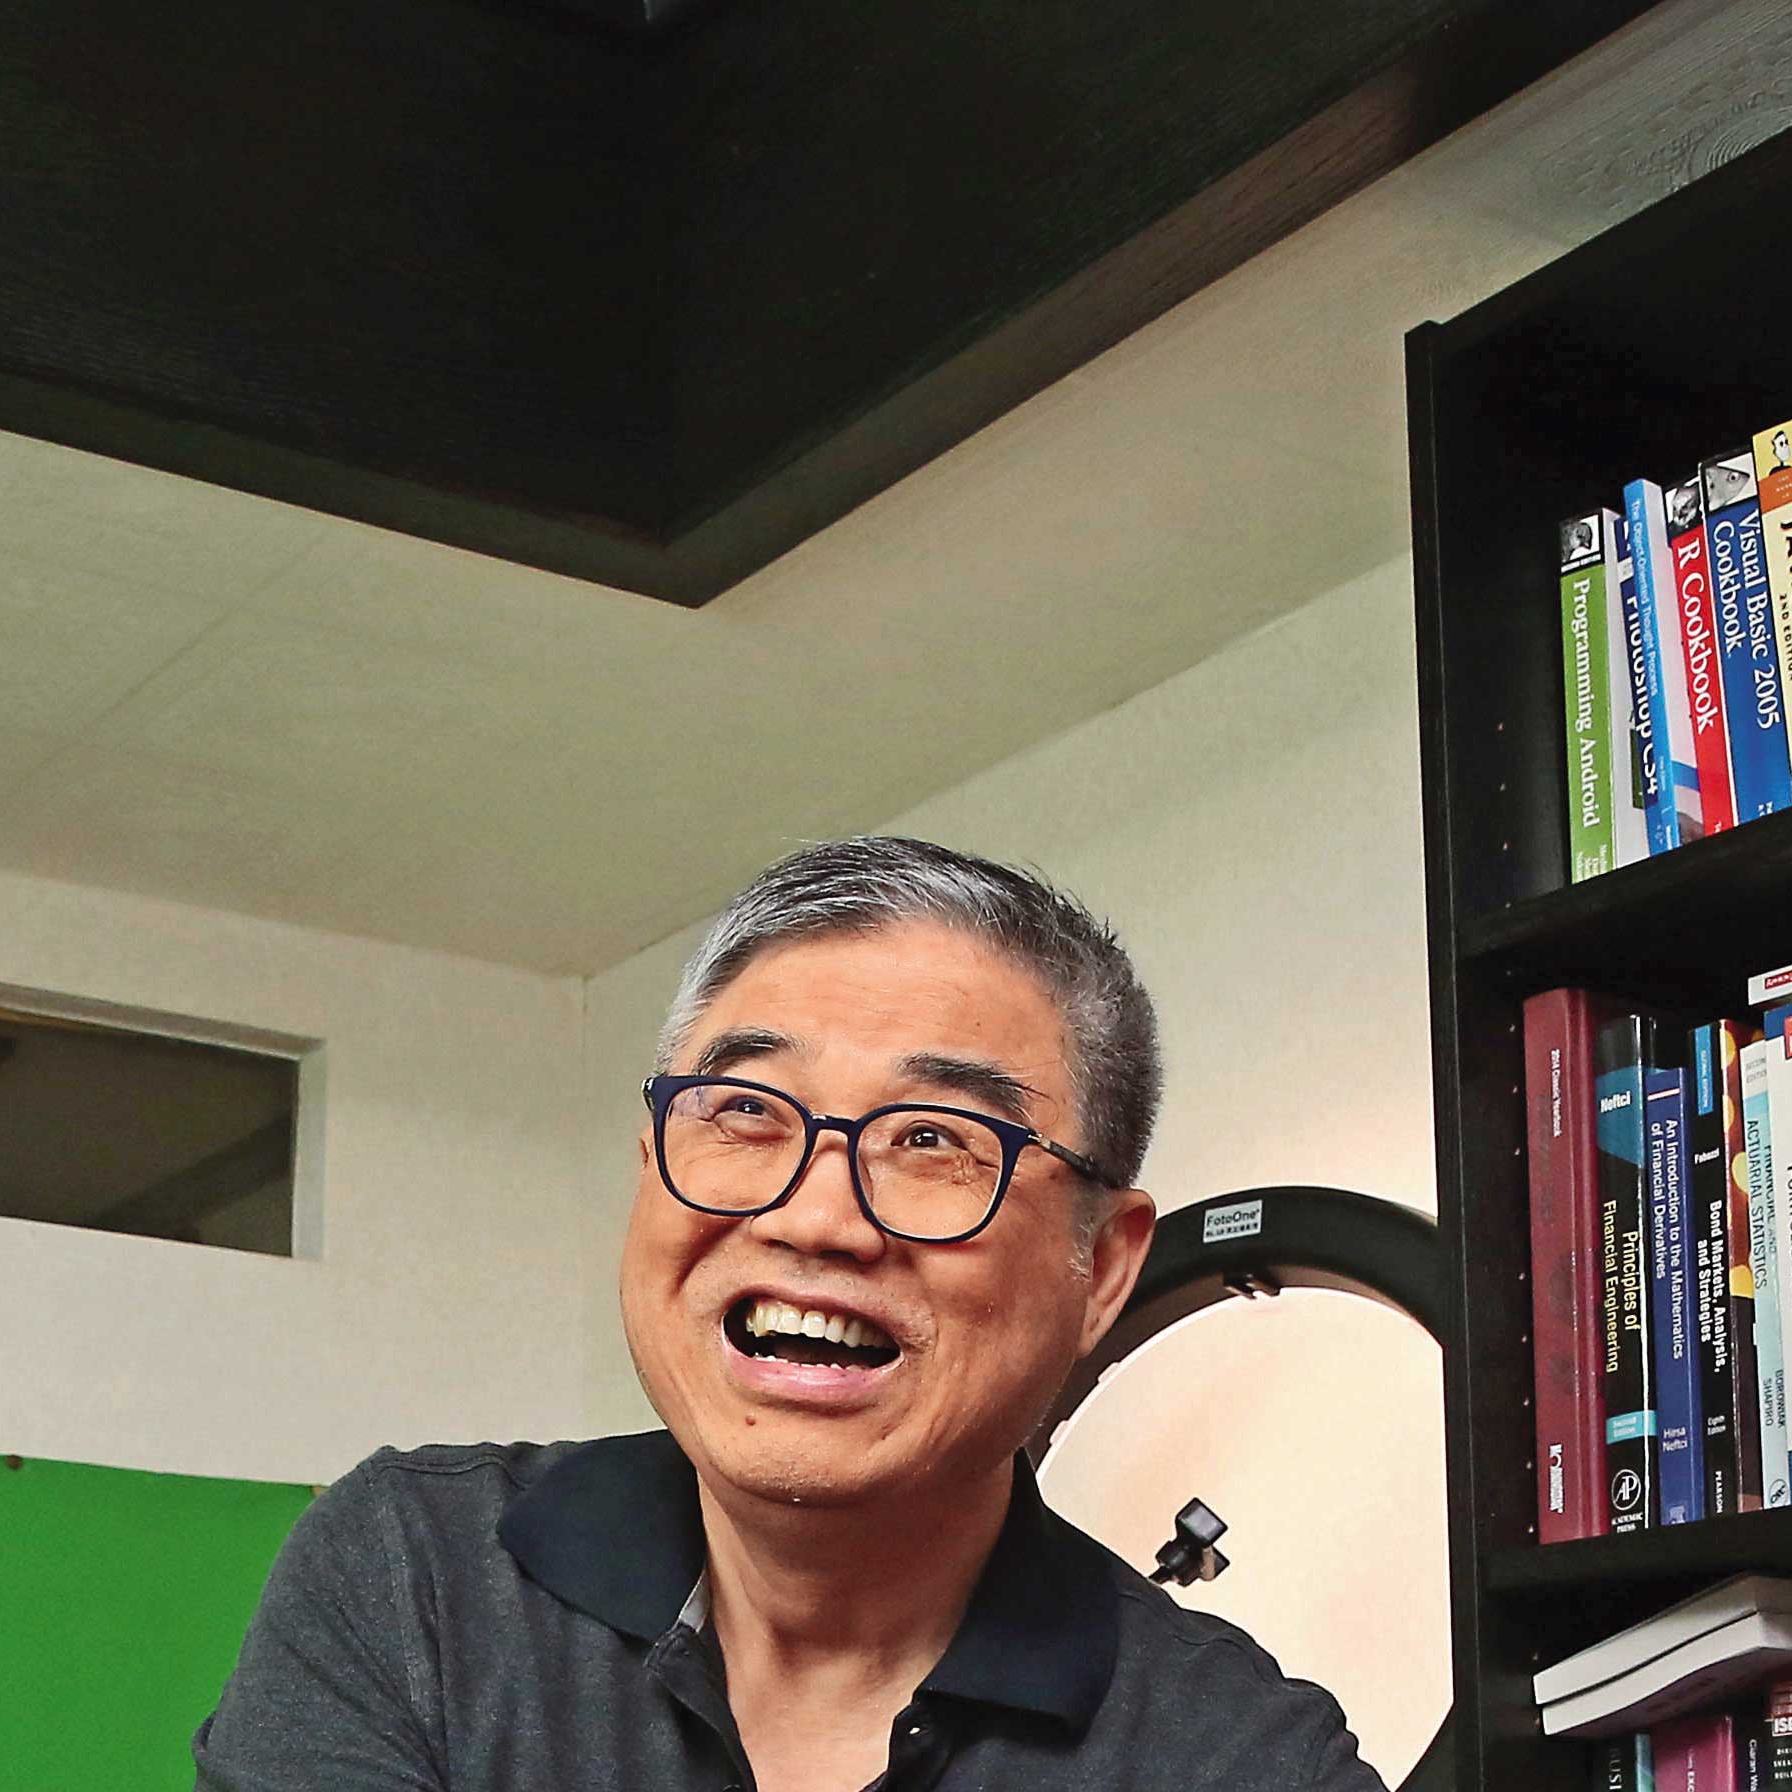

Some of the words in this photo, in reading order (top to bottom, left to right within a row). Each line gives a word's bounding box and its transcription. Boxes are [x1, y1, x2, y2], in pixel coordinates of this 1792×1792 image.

[1677, 538, 1700, 569] R
[1737, 509, 1764, 578] Visual
[1712, 520, 1743, 659] Cookbook
[1746, 581, 1769, 660] Basic
[1779, 593, 1789, 618] 2ND
[1571, 578, 1593, 733] Programming
[1681, 574, 1718, 735] Cookbook
[1754, 666, 1781, 729] 2005
[1575, 736, 1601, 828] Android
[1709, 1200, 1722, 1237] Bond
[1698, 1239, 1710, 1265] and
[1698, 1266, 1712, 1342] Strategies
[1762, 1378, 1774, 1428] SHAPIRO
[1773, 1368, 1786, 1429] BOROWIAK
